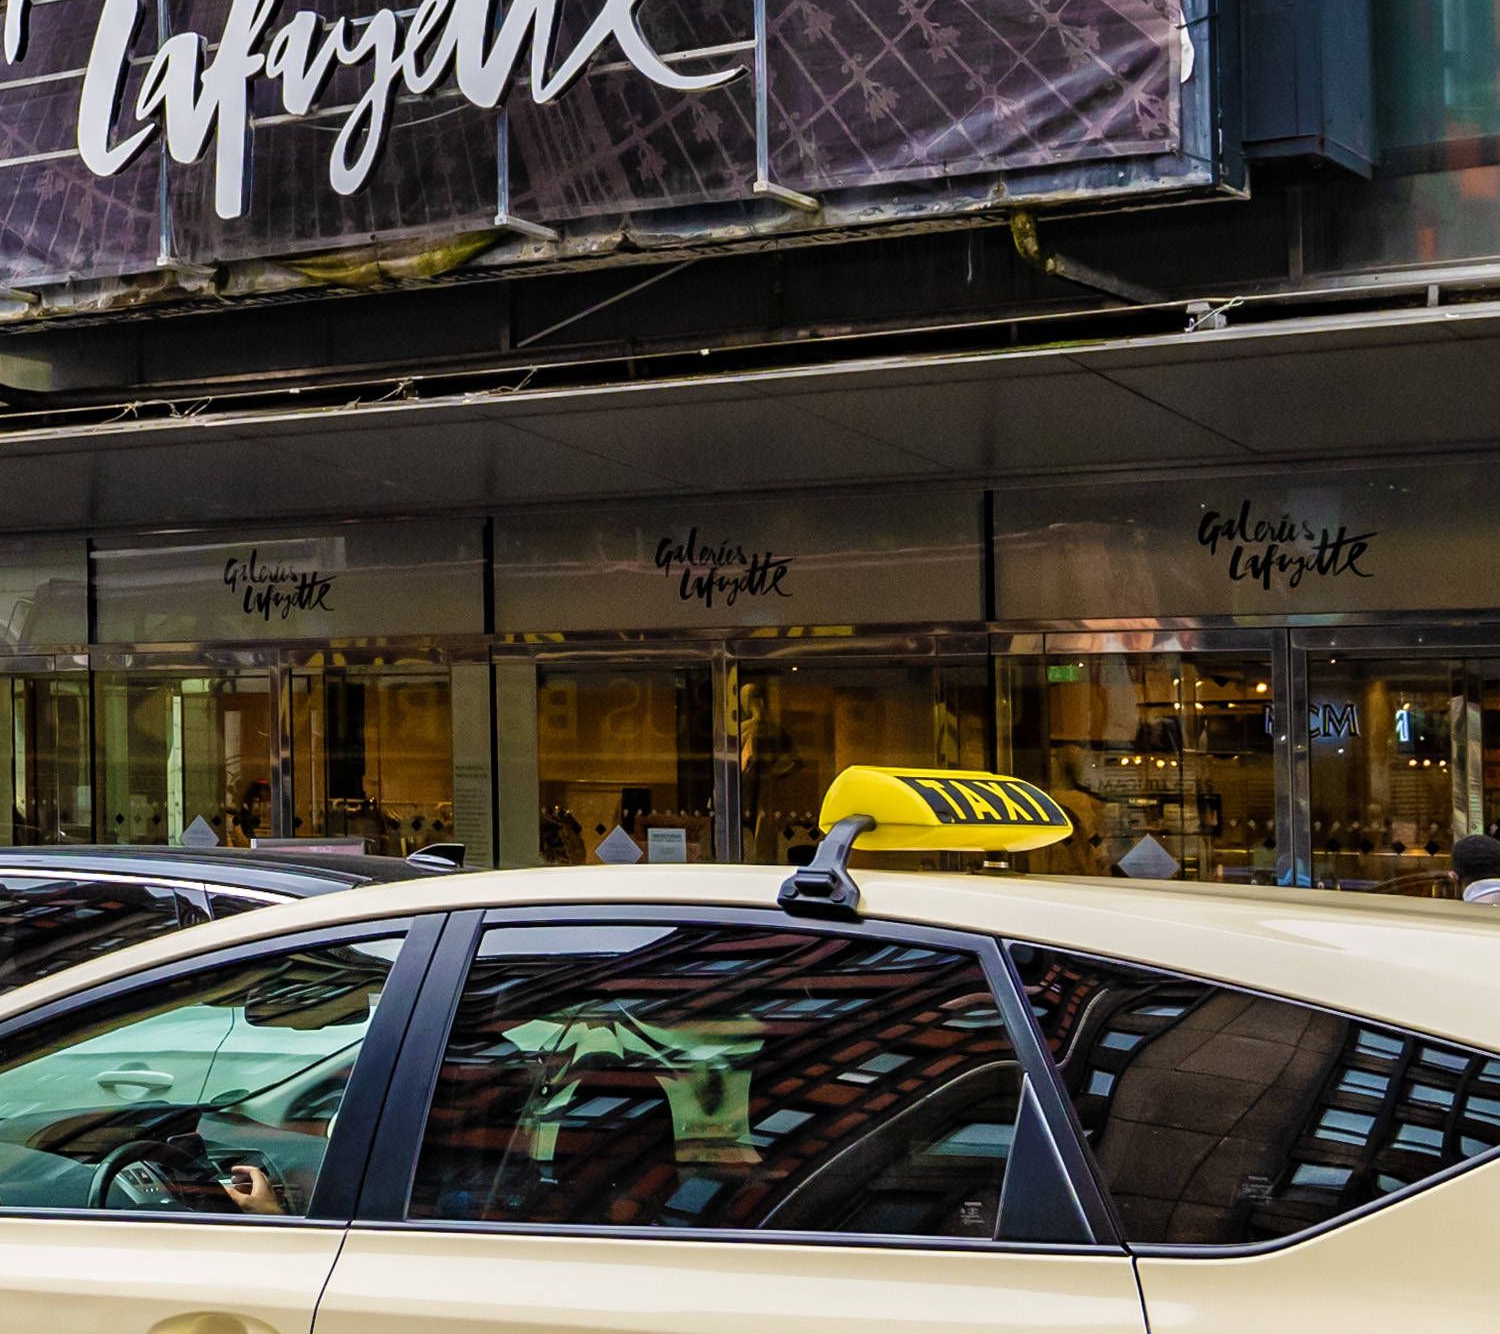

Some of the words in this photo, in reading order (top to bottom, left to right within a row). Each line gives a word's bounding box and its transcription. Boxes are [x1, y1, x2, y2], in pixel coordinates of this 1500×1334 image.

[654, 526, 748, 578] Galeries
[1197, 499, 1315, 556] Galeries
[223, 548, 299, 593] Galeries
[679, 551, 794, 608] Lafayette
[1228, 526, 1380, 591] Lafayette
[242, 570, 338, 622] Lafayette
[914, 778, 1051, 823] TAXI
